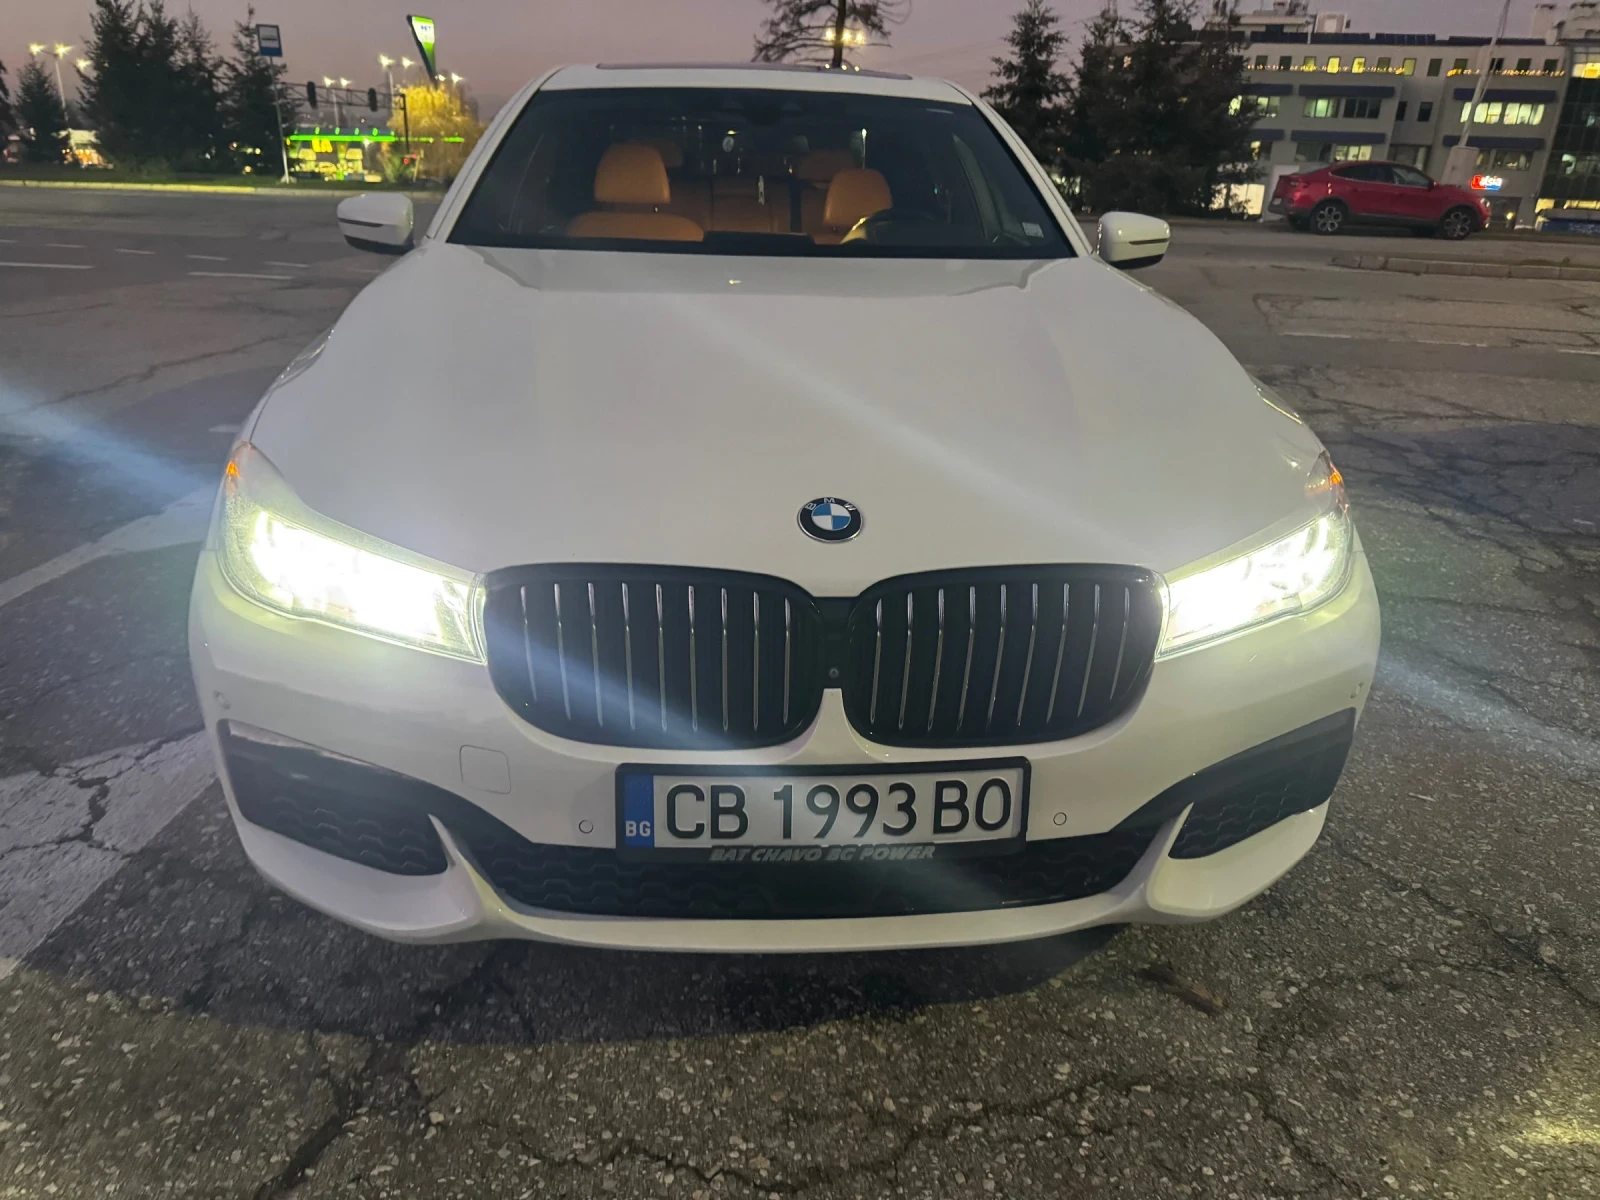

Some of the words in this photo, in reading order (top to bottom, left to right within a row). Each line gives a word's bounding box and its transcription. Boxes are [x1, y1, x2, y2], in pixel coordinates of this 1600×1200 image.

[804, 497, 857, 511] BMW
[666, 784, 749, 840] CB
[773, 782, 917, 840] 1993
[932, 778, 1012, 835] BO
[625, 820, 651, 837] BG
[710, 847, 752, 862] BAT
[826, 846, 858, 862] BG
[859, 844, 936, 861] POWER
